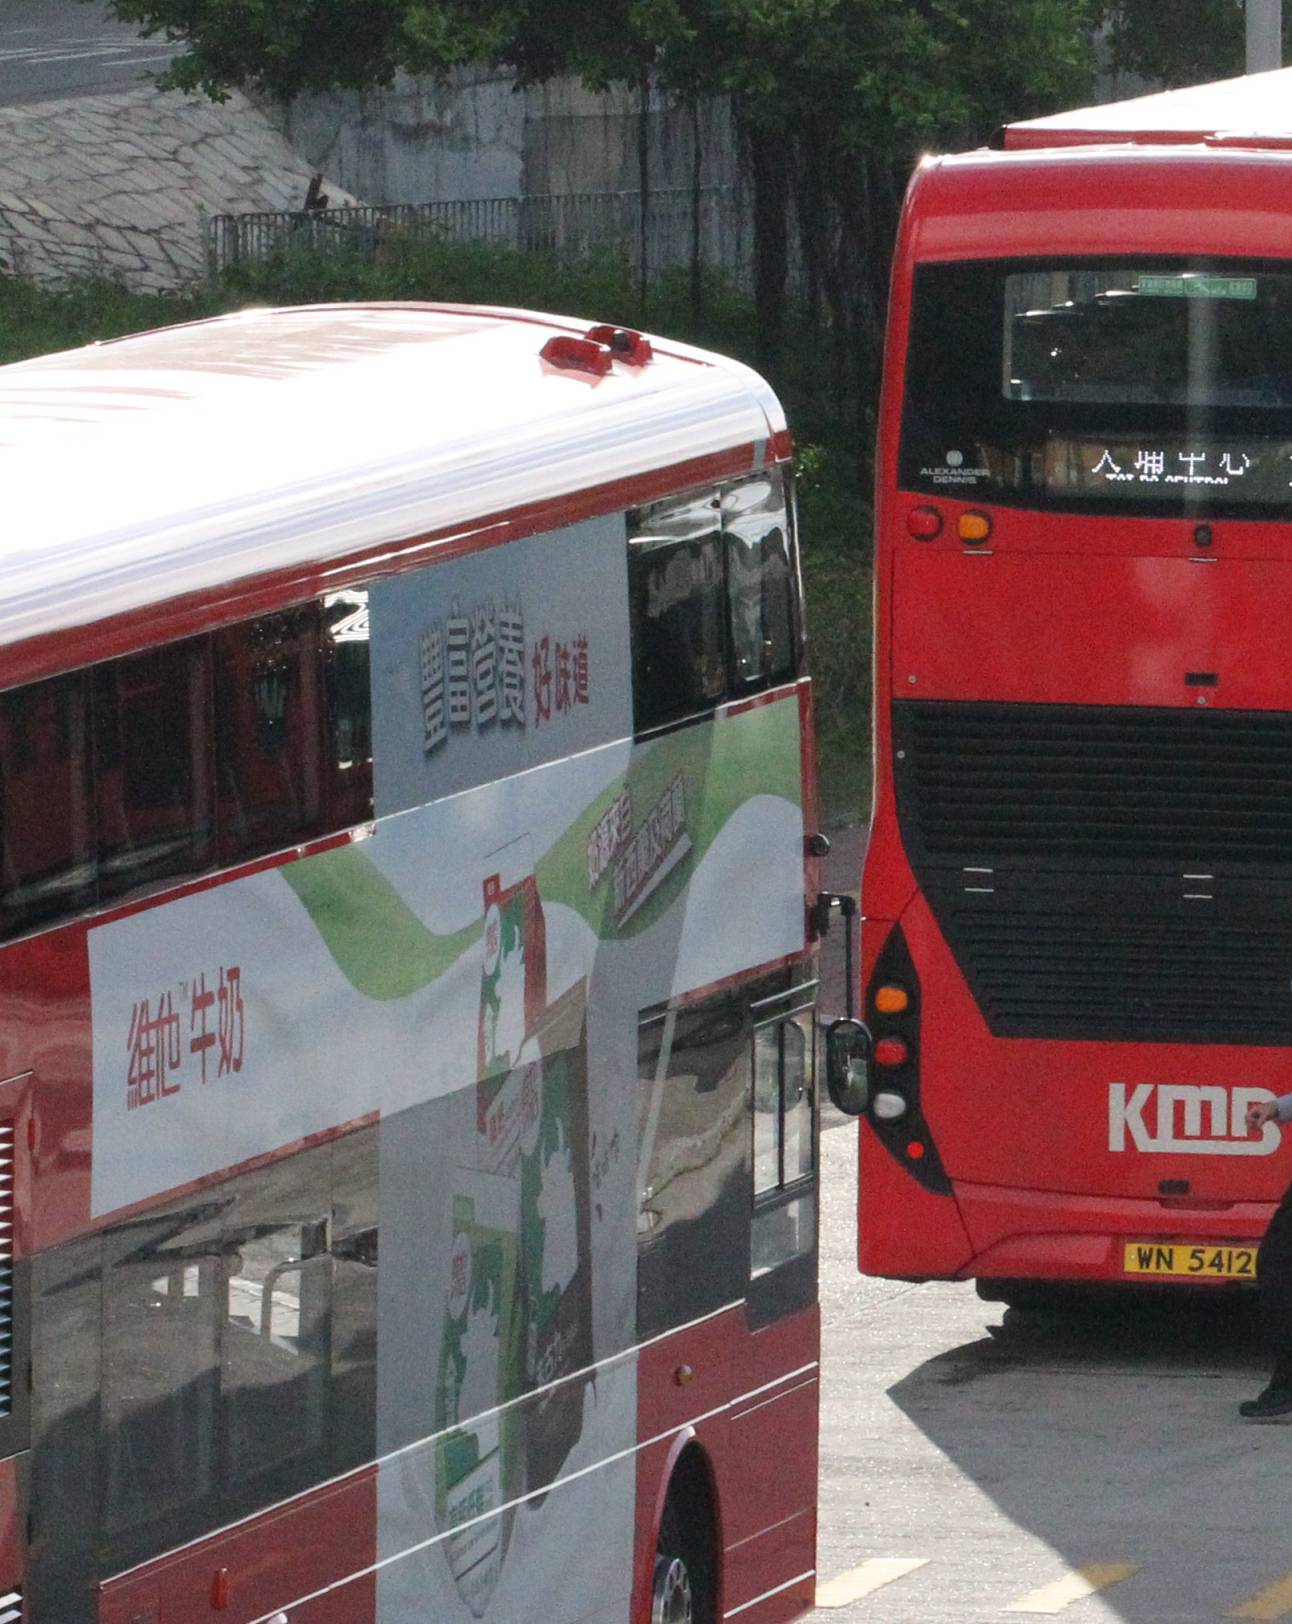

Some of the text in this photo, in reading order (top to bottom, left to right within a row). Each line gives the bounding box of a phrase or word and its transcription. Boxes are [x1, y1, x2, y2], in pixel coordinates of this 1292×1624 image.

[919, 467, 991, 476] ALEXANDER
[932, 476, 977, 485] DENNIS
[532, 632, 589, 728] 好味道
[1108, 1082, 1282, 1156] KMB
[1136, 1247, 1253, 1275] WN 5412
